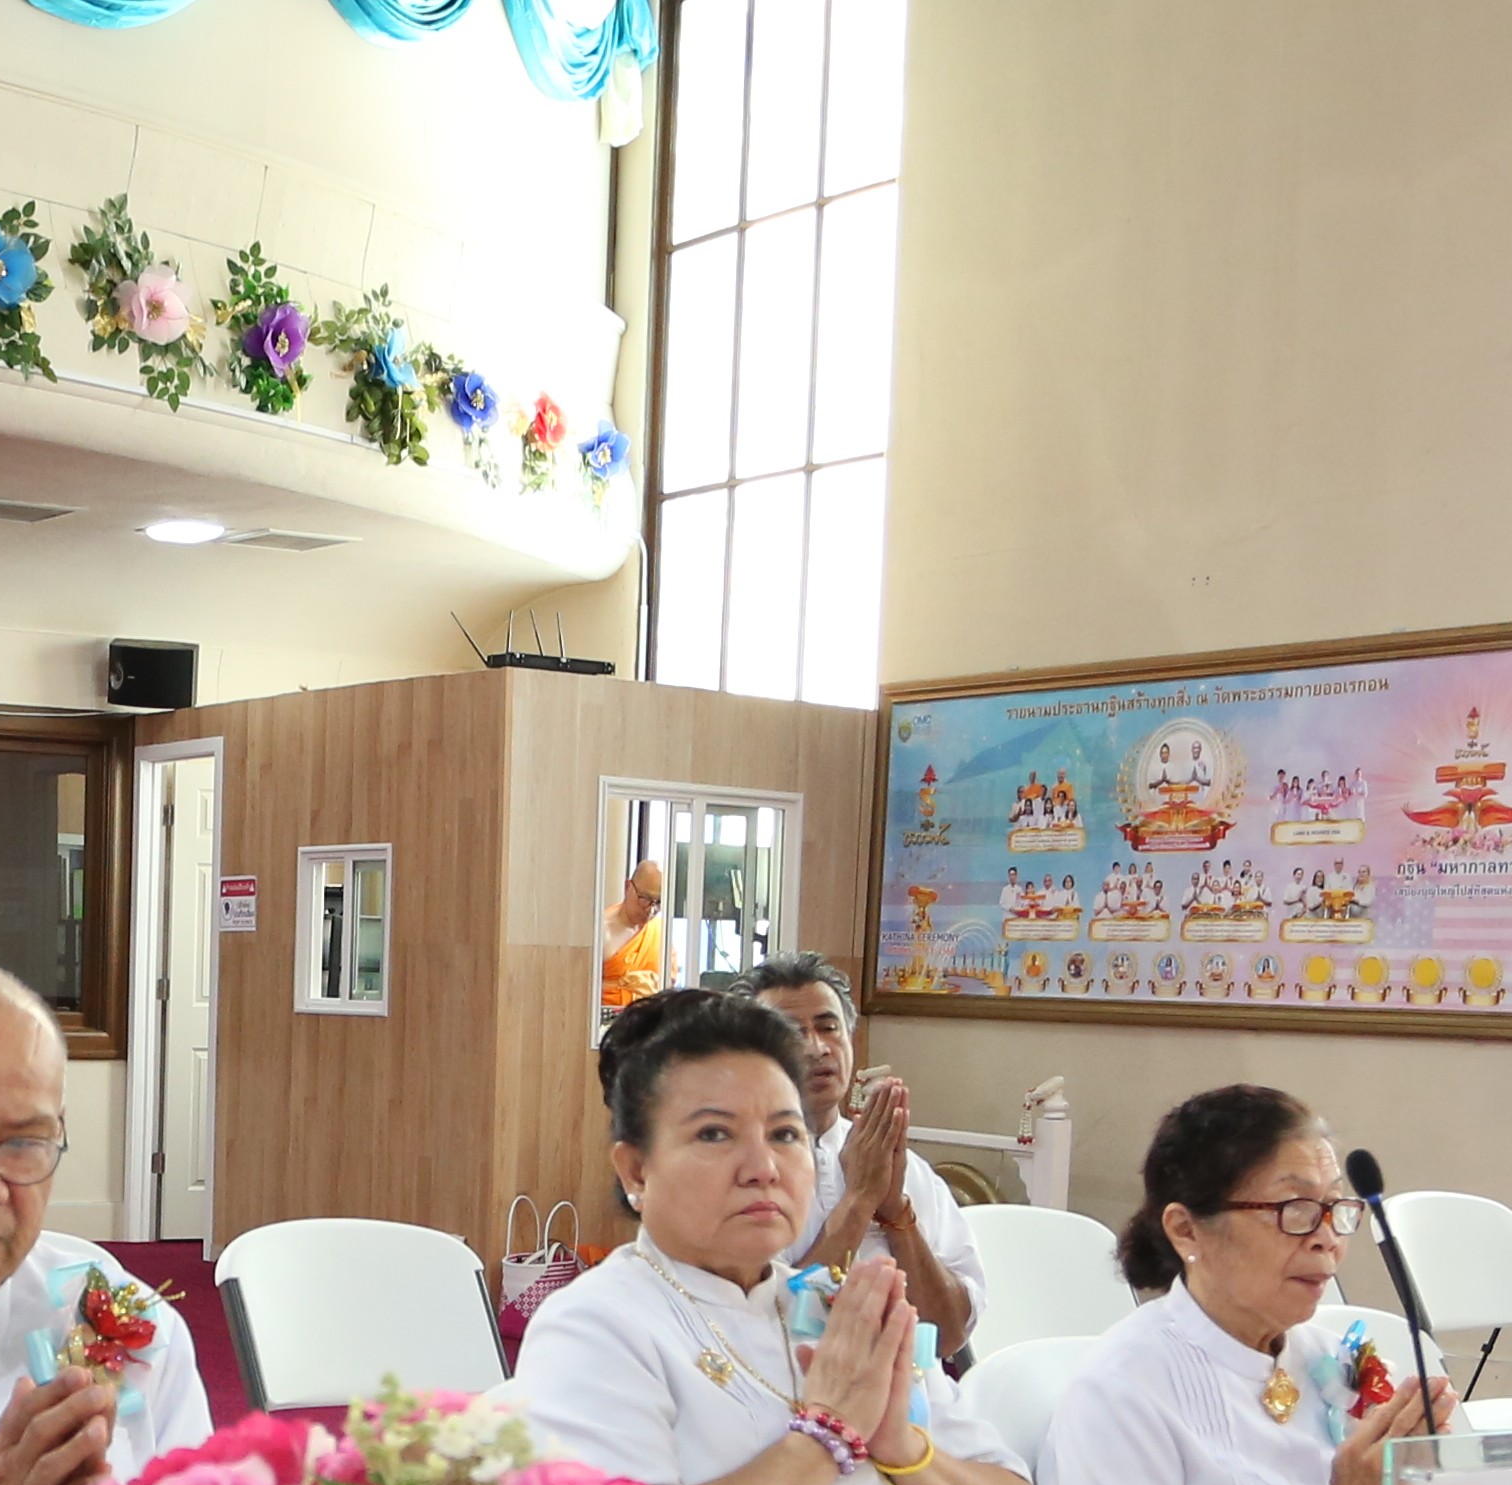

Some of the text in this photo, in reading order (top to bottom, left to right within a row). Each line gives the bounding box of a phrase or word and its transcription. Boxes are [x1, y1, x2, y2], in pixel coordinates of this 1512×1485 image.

[1213, 678, 1390, 705] วัดพระธรรมกายออเรกอน
[1397, 858, 1426, 881] กฐิน
